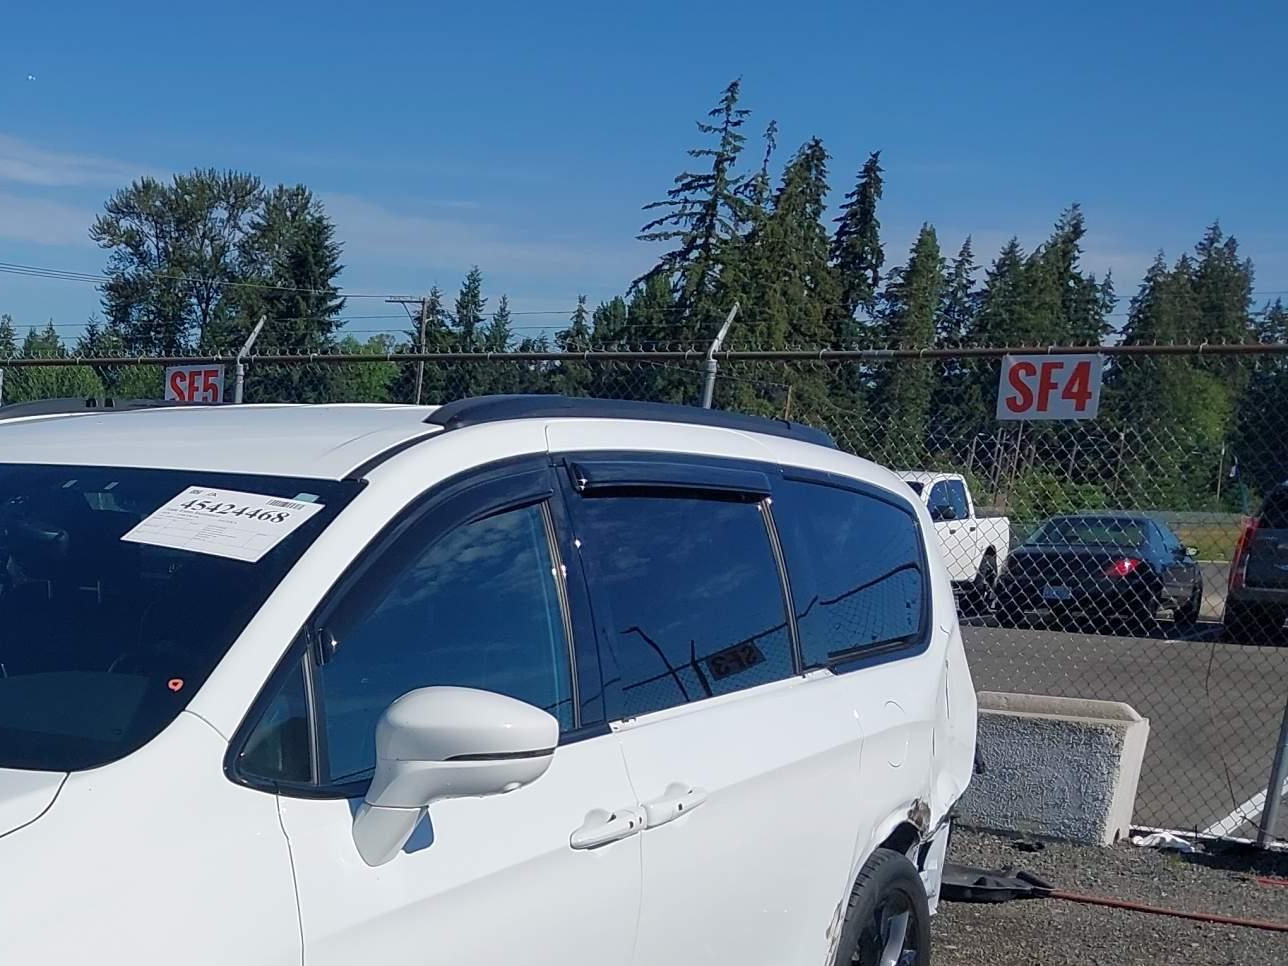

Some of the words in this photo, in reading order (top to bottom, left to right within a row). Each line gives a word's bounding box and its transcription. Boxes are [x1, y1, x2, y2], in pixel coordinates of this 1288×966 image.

[170, 370, 219, 401] SF5
[1006, 361, 1092, 413] SF4
[180, 500, 290, 523] 45424468
